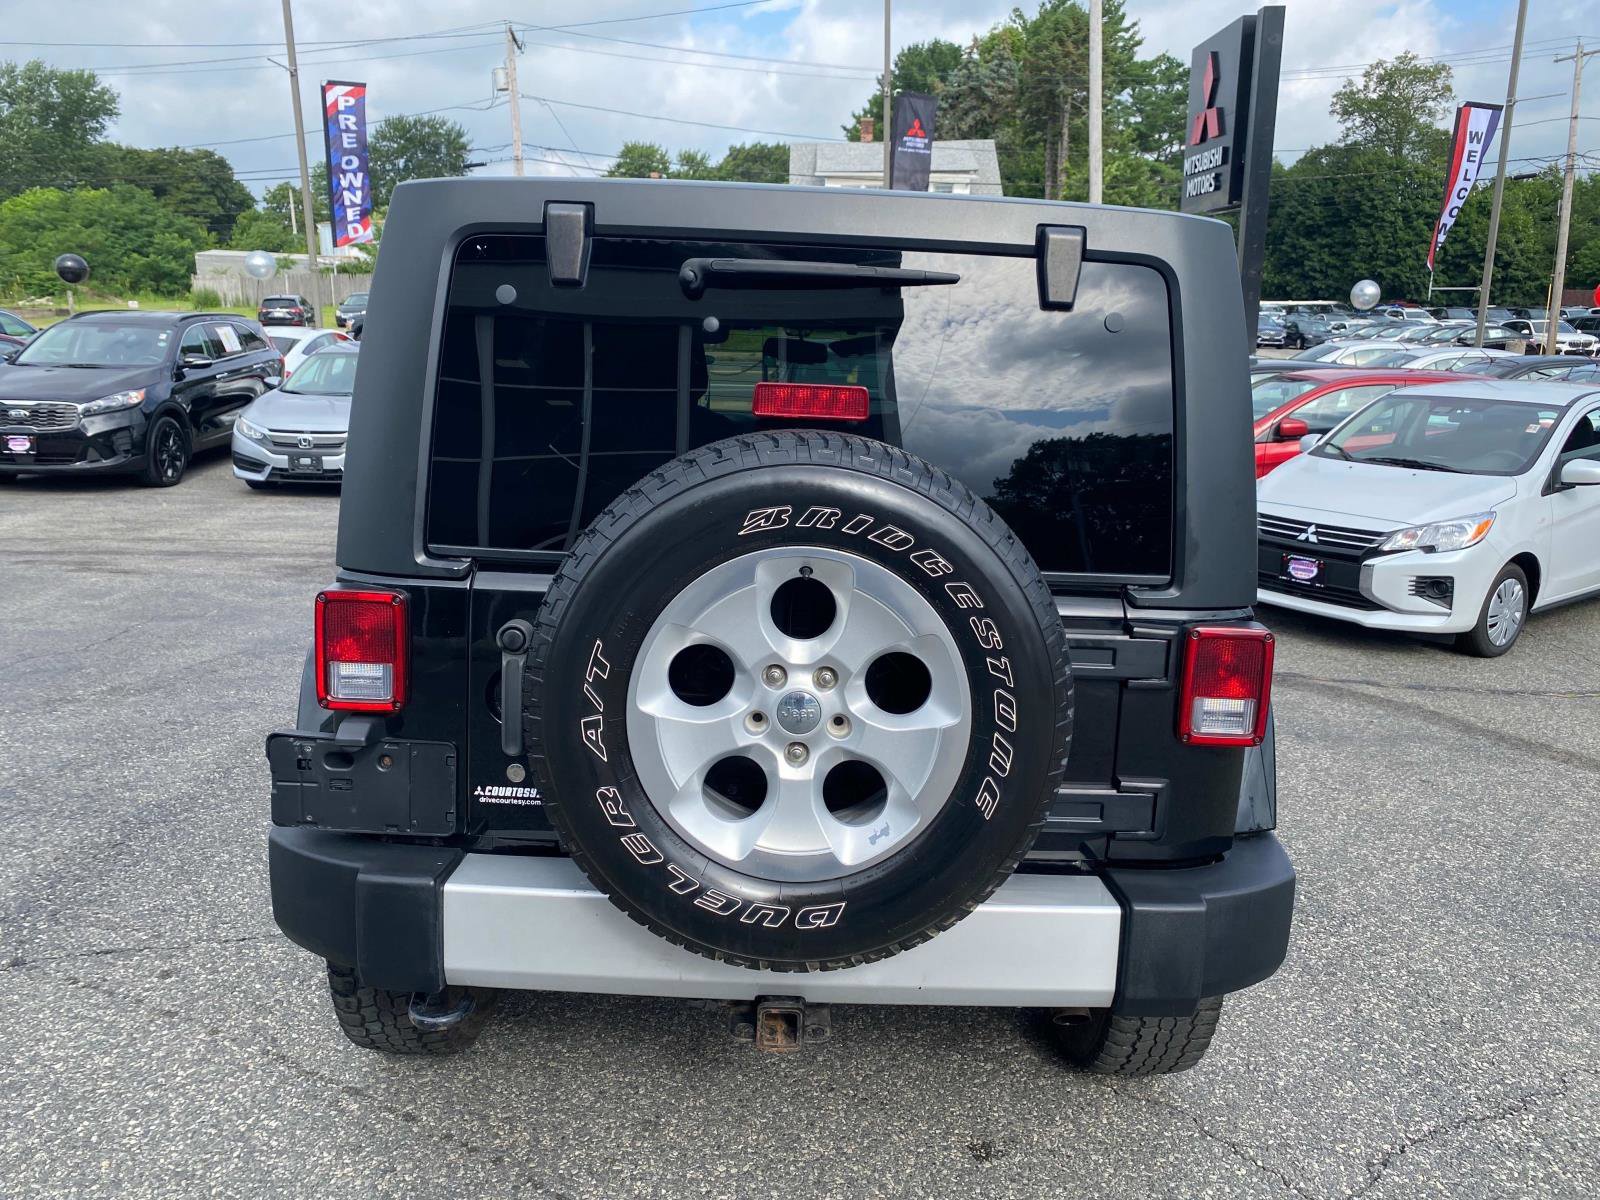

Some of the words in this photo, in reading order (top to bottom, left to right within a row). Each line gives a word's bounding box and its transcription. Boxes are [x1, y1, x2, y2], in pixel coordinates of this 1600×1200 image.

[337, 95, 358, 148] PRE
[1183, 146, 1223, 177] MITSUBISHI
[1186, 172, 1216, 198] MOTORS
[1437, 130, 1484, 247] WELCOM
[339, 155, 364, 239] OWNED
[738, 505, 1016, 820] BRIDGESTONE
[581, 638, 610, 762] A/T
[781, 706, 816, 719] Jeep
[479, 797, 541, 806] drivecourtesy.com
[596, 786, 848, 929] DUELER
